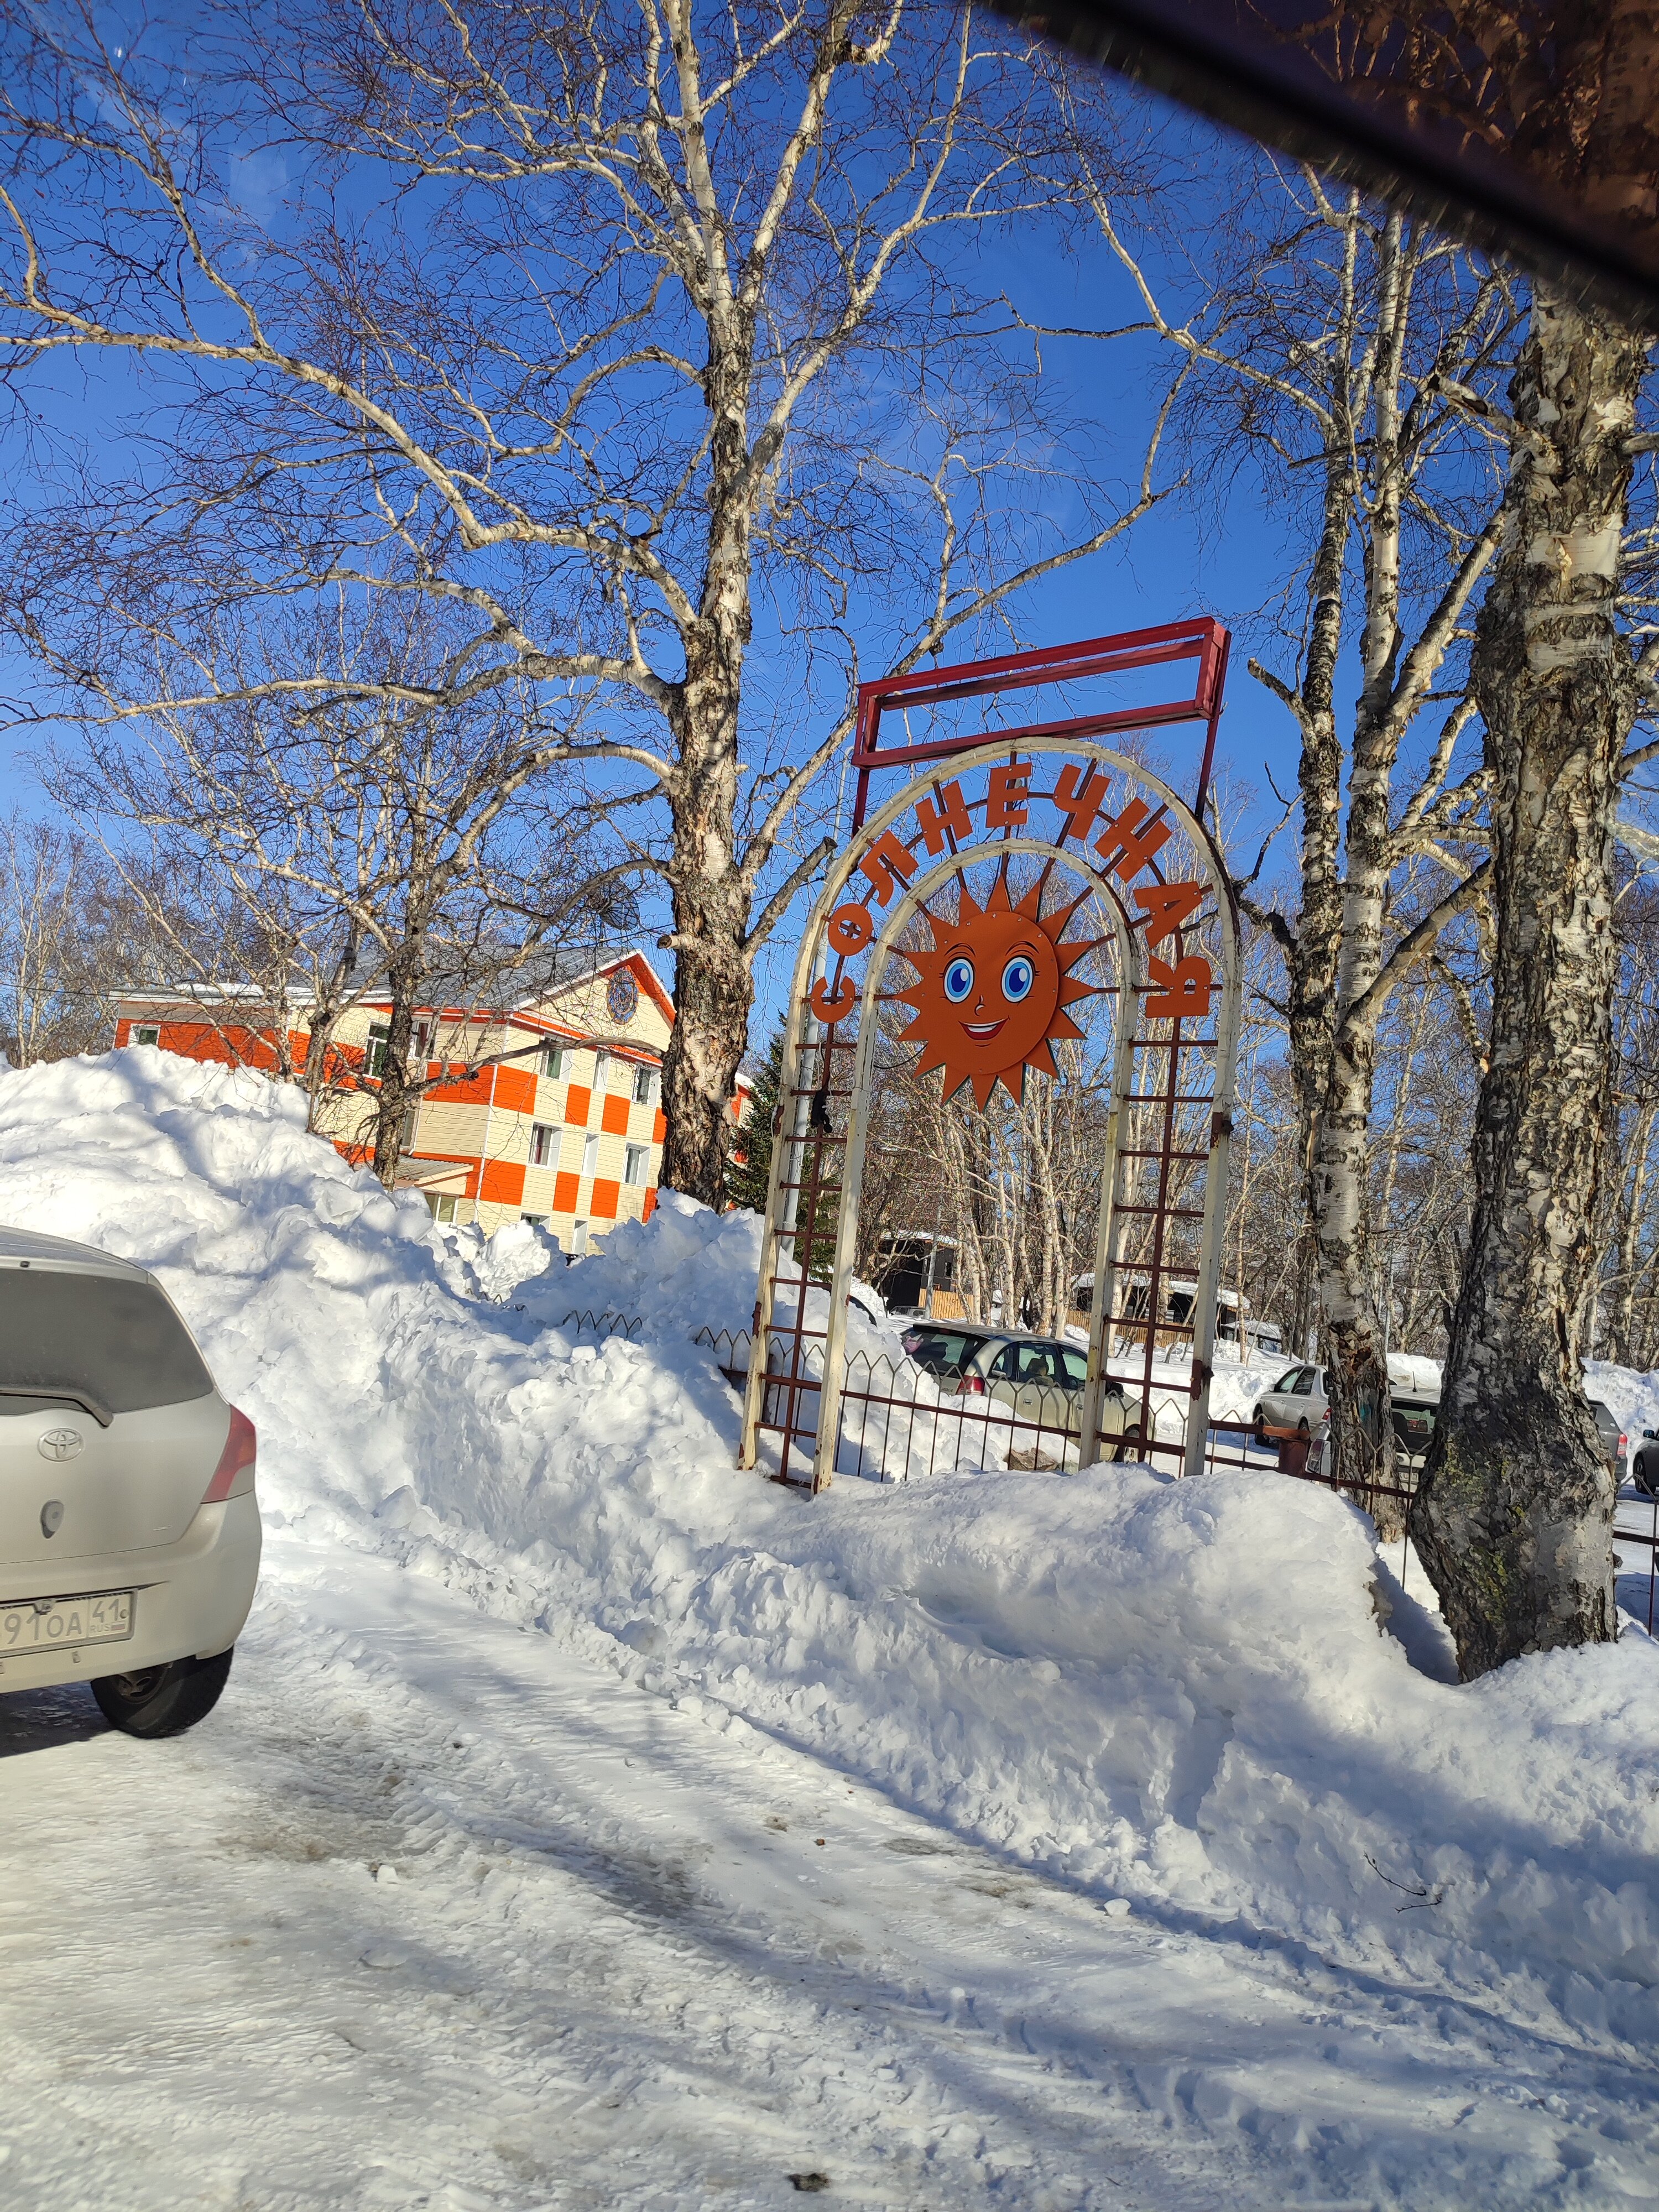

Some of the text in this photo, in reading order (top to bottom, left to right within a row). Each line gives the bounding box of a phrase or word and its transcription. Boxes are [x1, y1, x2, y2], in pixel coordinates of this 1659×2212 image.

[810, 762, 1211, 1023] СОЛНЕЧНАЯ
[92, 1598, 119, 1623] 41
[90, 1623, 111, 1632] RUS
